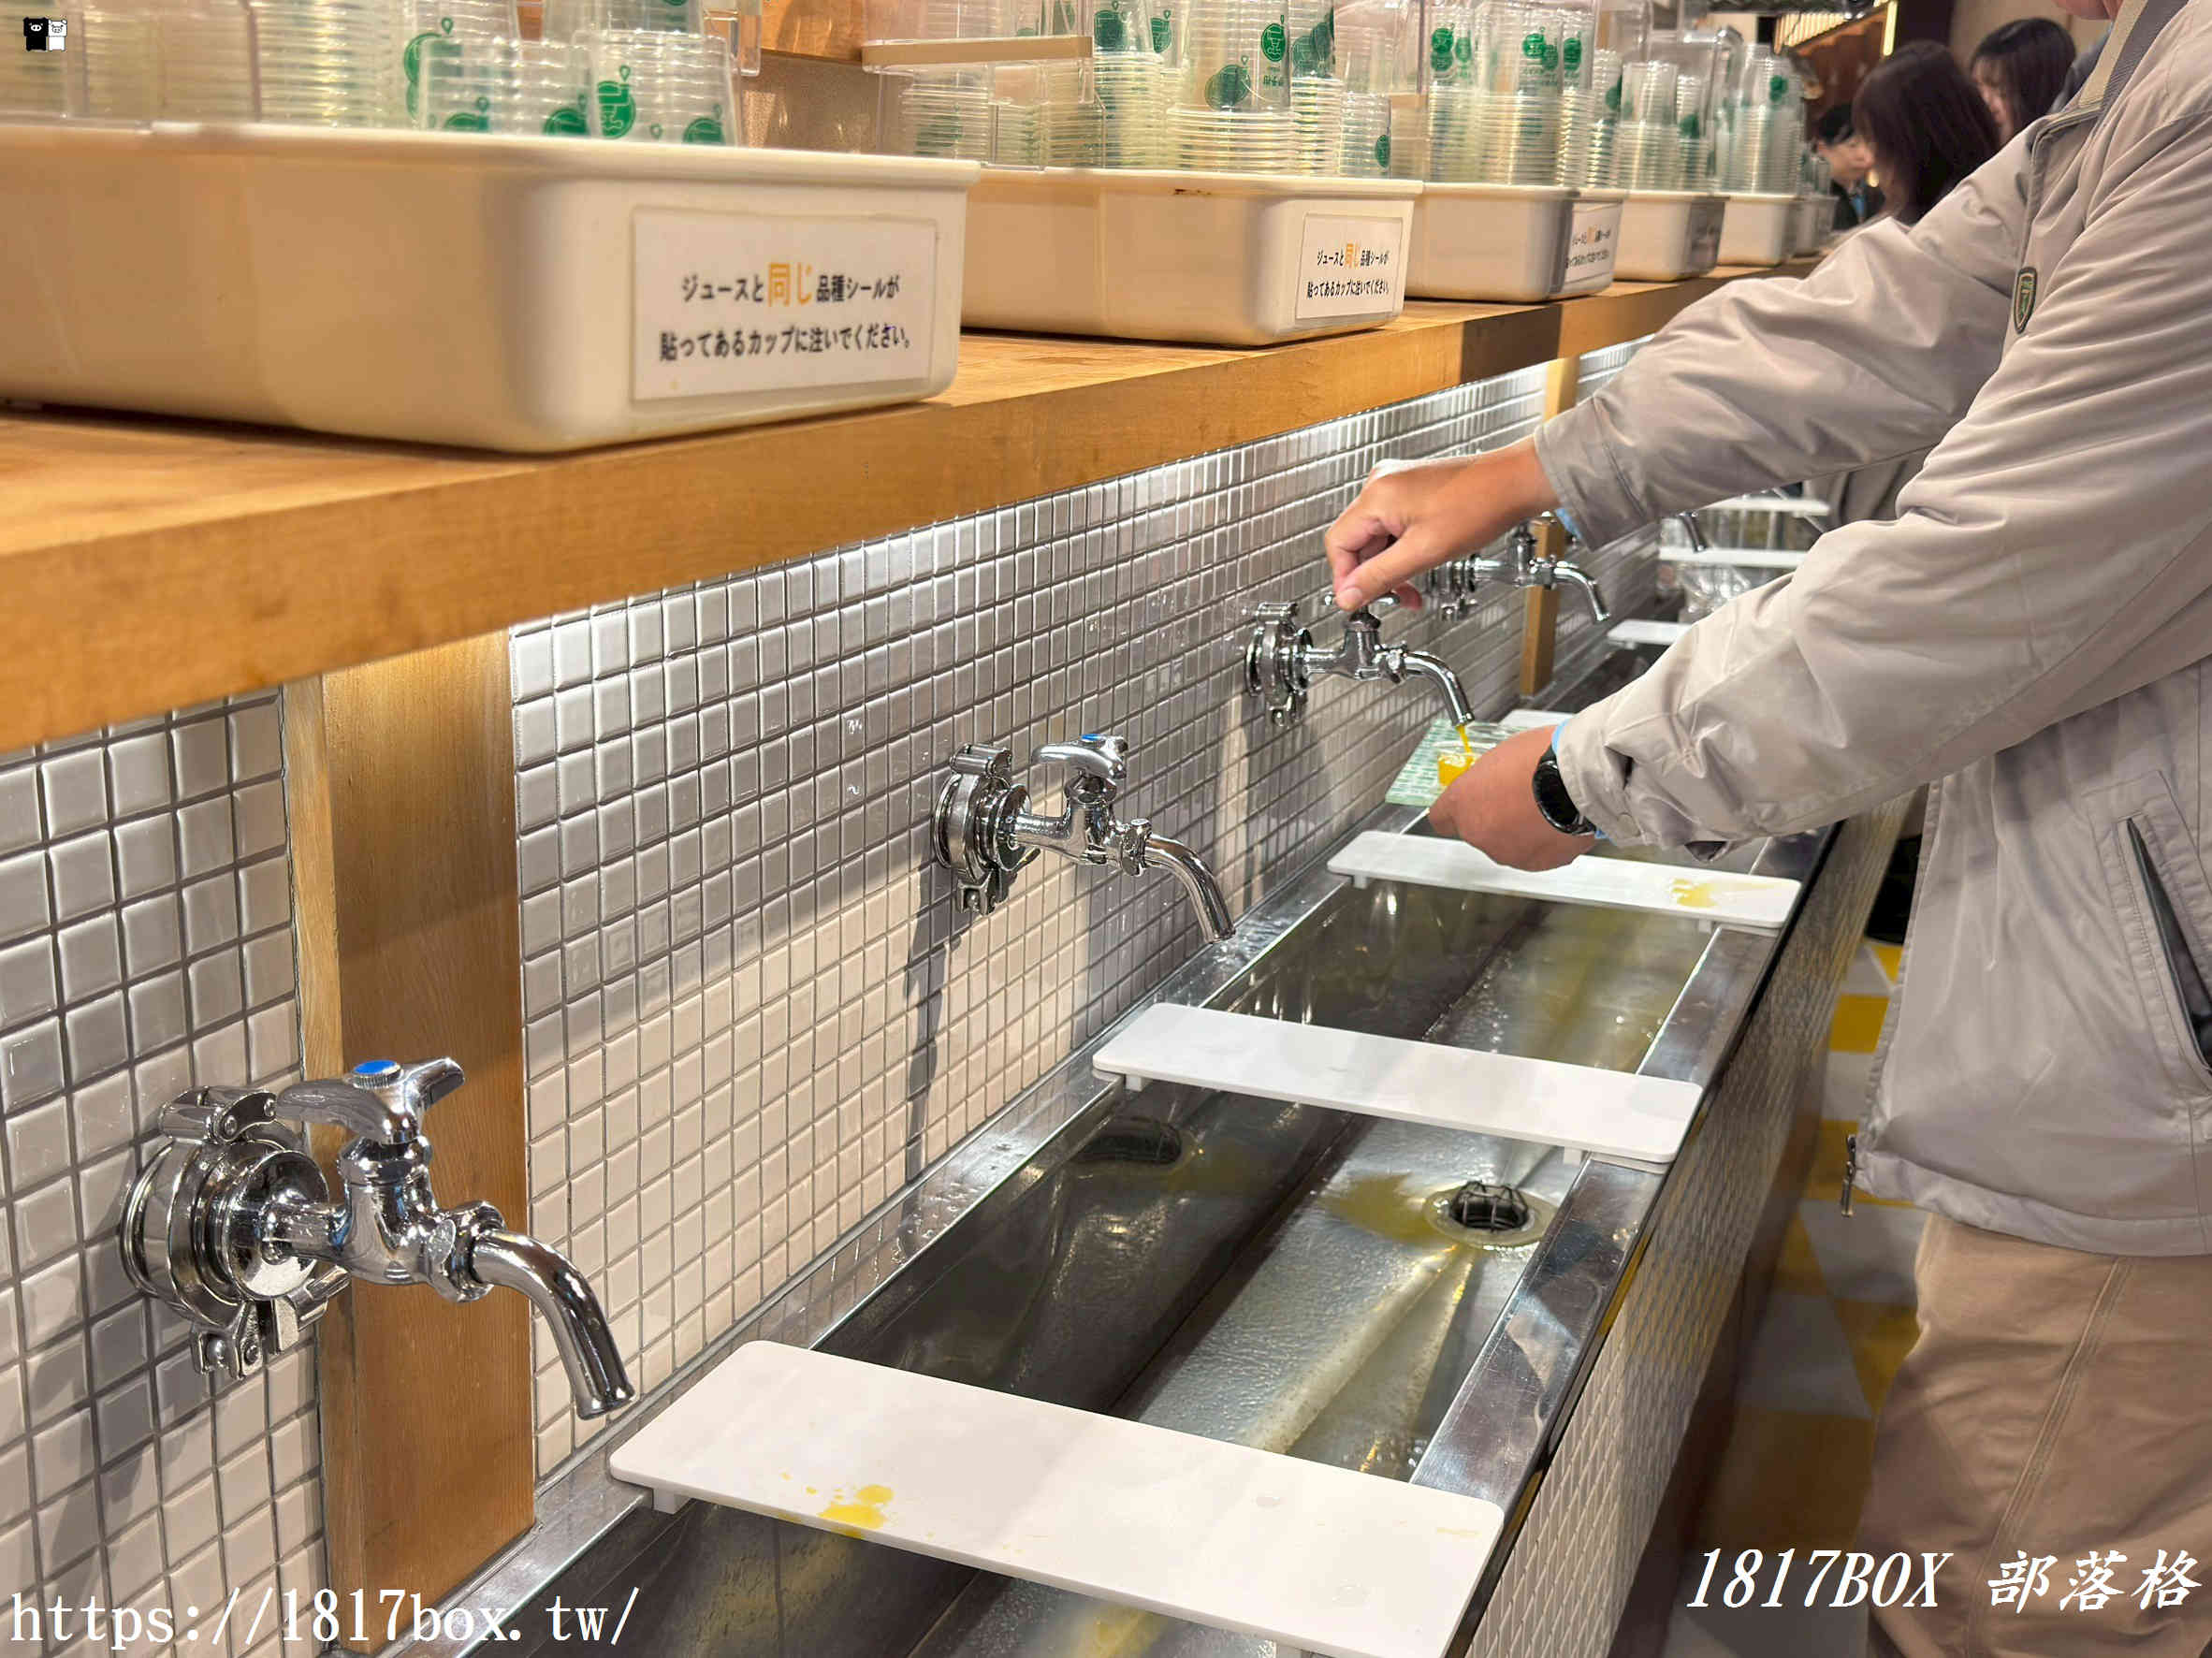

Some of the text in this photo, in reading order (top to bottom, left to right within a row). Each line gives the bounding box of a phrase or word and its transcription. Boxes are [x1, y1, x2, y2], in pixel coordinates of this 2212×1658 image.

[680, 262, 900, 307] ジュースと同じ品種シールが
[659, 323, 910, 362] 貼ってあるカップに注いでください。
